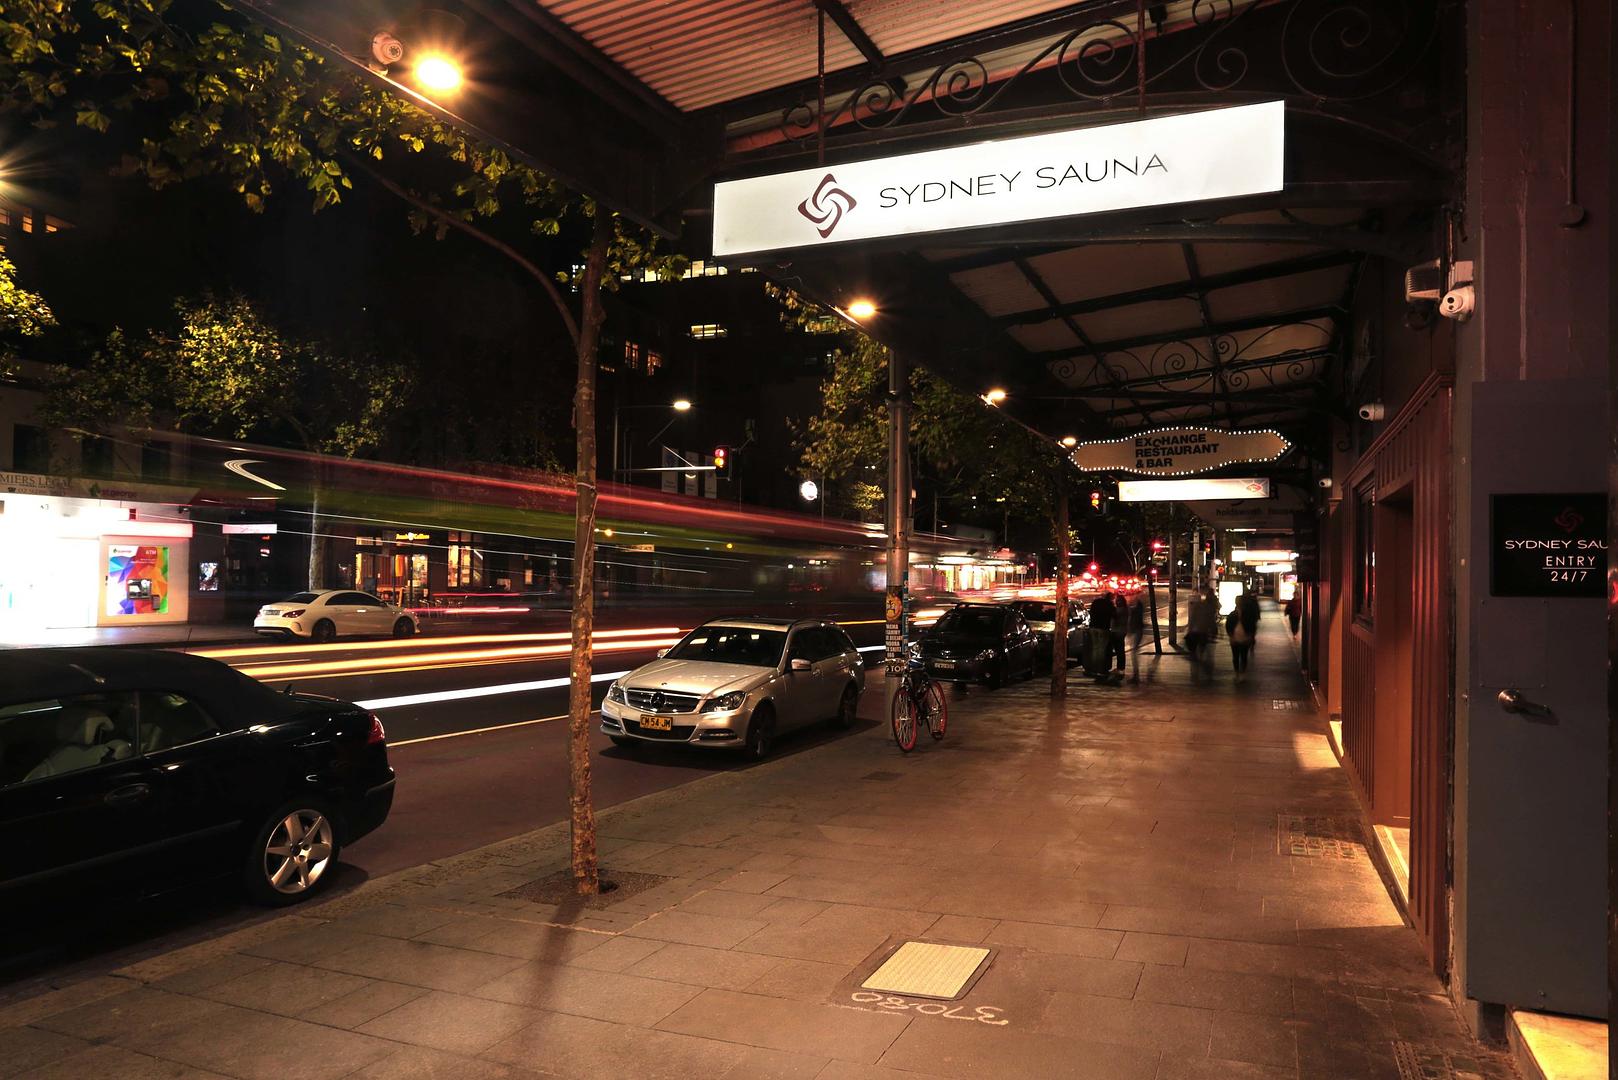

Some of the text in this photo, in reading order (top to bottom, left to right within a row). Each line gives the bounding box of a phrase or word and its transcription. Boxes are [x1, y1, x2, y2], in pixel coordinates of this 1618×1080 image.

[879, 153, 1169, 209] SYDNEY SAUNA
[1135, 433, 1206, 447] EXCHANGE
[1135, 443, 1220, 458] RESTAURANT
[1135, 457, 1173, 468] & BAR
[1505, 539, 1572, 550] SYDNEY
[1545, 555, 1596, 567] ENTRY
[1550, 570, 1588, 583] 24/7
